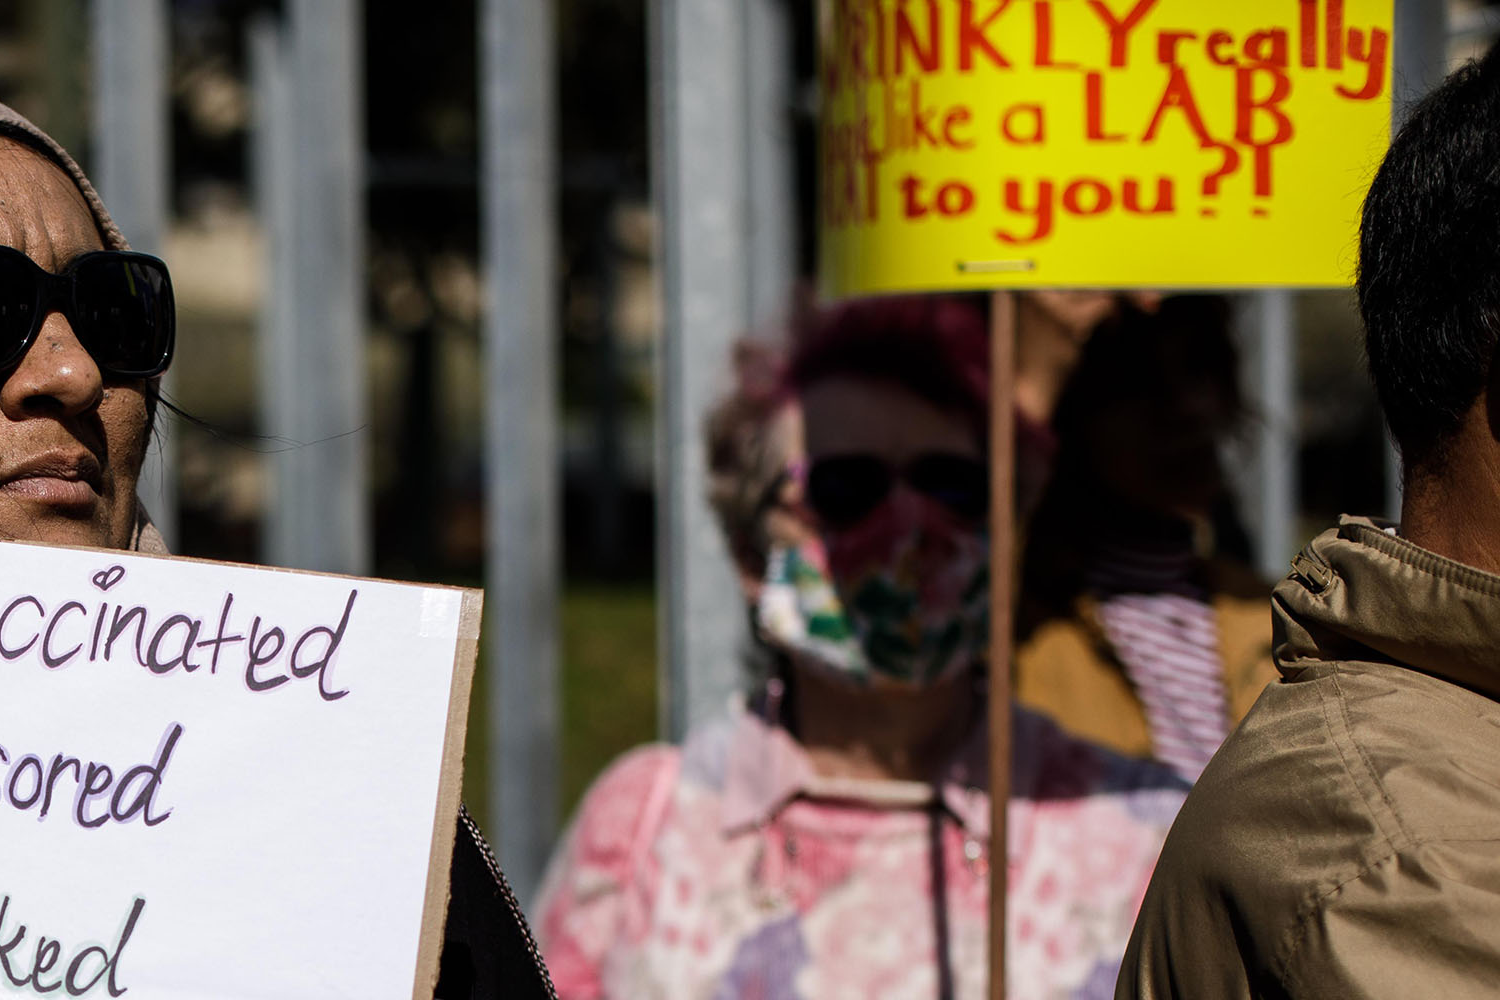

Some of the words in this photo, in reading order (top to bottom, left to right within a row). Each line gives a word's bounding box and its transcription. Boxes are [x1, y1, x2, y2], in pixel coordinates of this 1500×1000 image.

[1156, 0, 1389, 100] really
[1000, 103, 1047, 146] a
[1082, 66, 1296, 148] LAB
[900, 171, 975, 218] to
